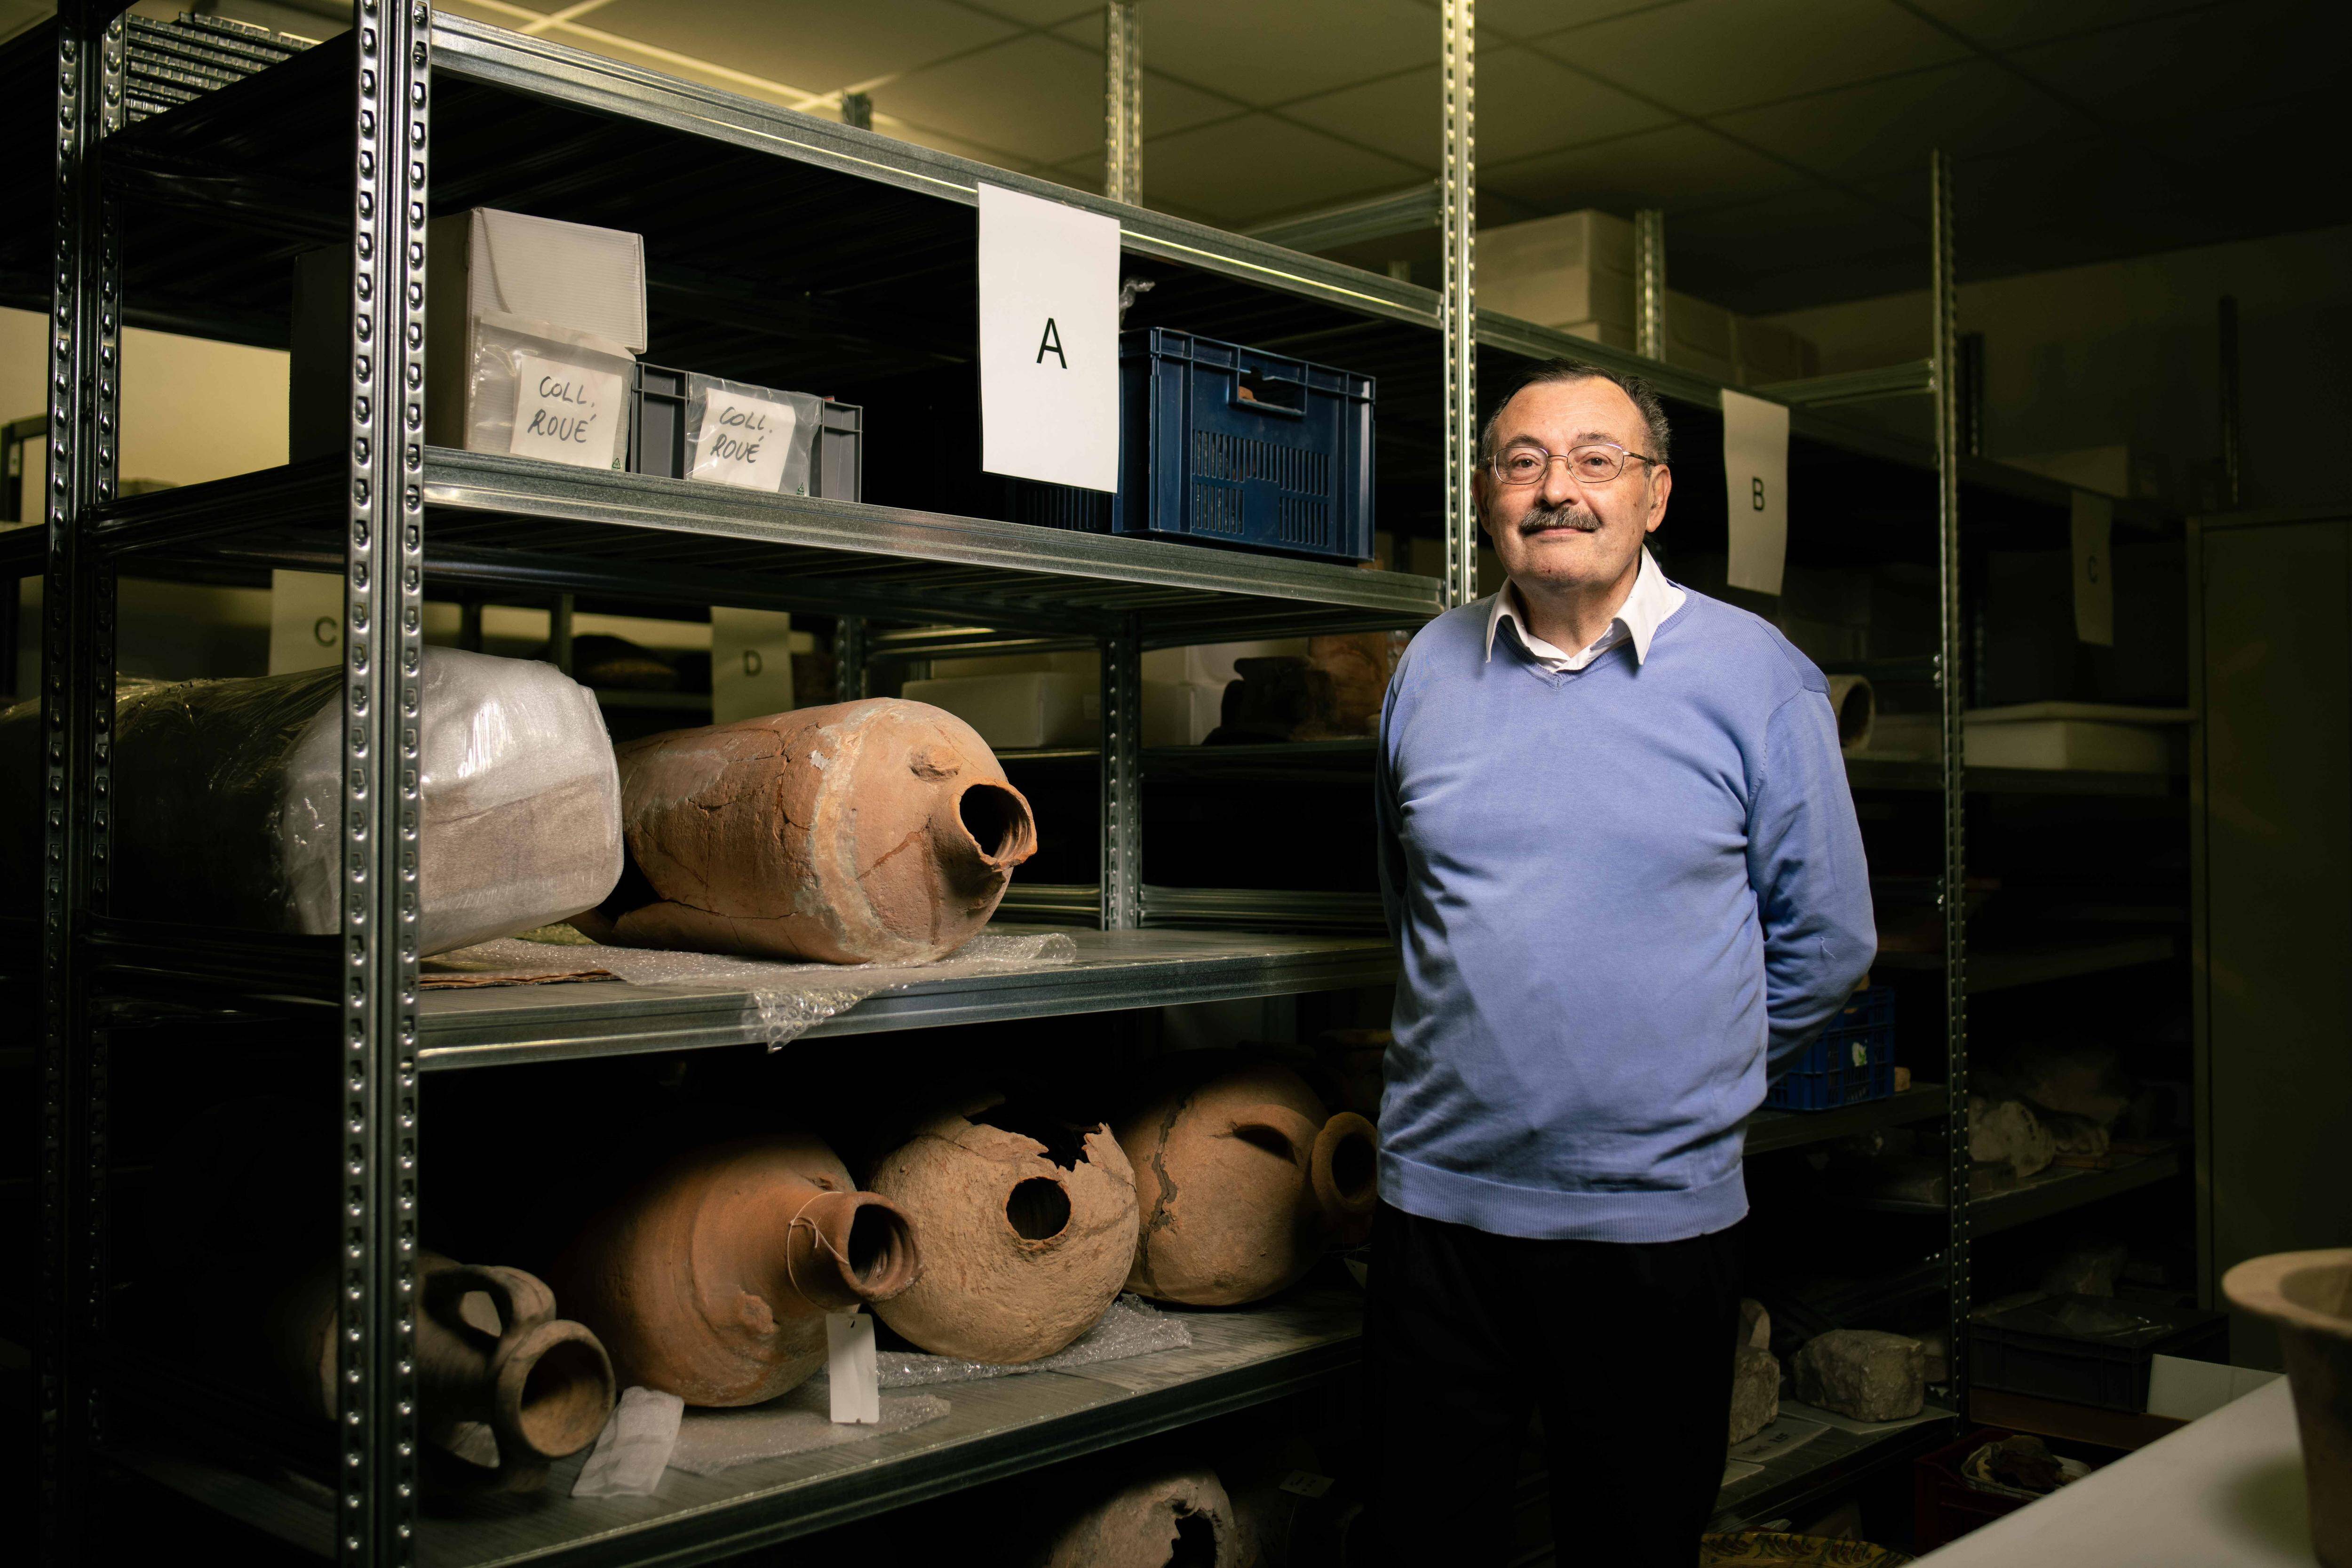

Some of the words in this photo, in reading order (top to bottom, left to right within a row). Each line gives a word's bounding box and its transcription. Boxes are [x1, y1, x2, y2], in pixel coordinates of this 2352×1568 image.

[1036, 318, 1068, 369] A
[539, 375, 596, 408] COLL.
[527, 408, 596, 444] ROUÉ
[719, 406, 773, 434] COLL.
[710, 433, 764, 463] ROUÉ
[1752, 477, 1764, 511] B
[2087, 556, 2098, 583] C
[314, 615, 337, 647] C
[743, 650, 762, 677] D
